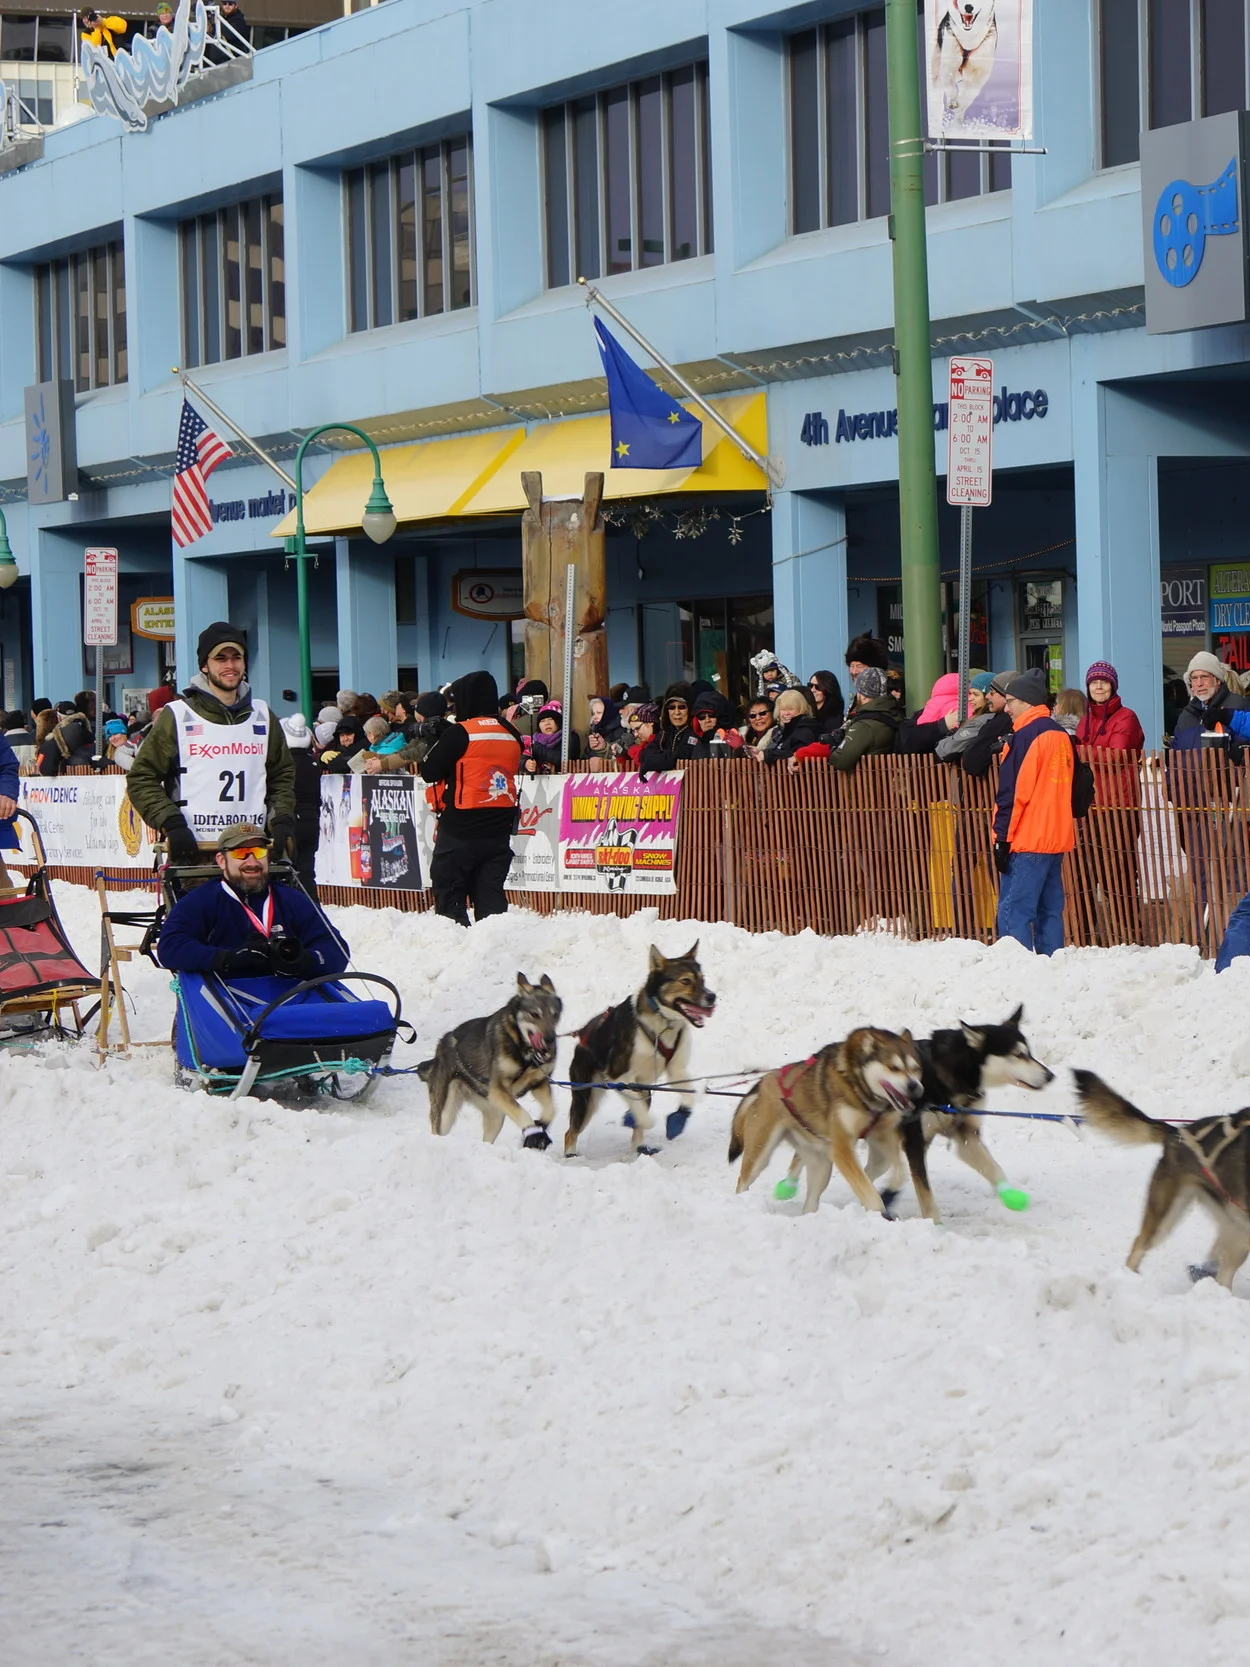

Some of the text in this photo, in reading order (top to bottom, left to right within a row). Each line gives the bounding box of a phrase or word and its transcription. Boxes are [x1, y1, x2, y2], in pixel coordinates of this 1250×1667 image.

[951, 382, 991, 396] NO PARKING
[953, 414, 988, 423] 2:00 AM
[800, 411, 829, 446] 4th
[952, 434, 988, 444] 6:00 AM
[956, 476, 982, 486] STREET
[951, 488, 987, 498] CLEANING
[86, 564, 96, 575] NO
[1161, 579, 1205, 607] PORT
[1214, 603, 1232, 628] DRY
[189, 743, 264, 759] ExxonMobil
[218, 770, 246, 802] 21
[593, 786, 651, 795] ALASKA
[29, 787, 78, 804] PROVIDENCE
[370, 789, 415, 828] ALASKAN
[608, 796, 640, 820] DIVING
[640, 795, 675, 821] SUPPLY
[193, 814, 248, 826] IDITAROD
